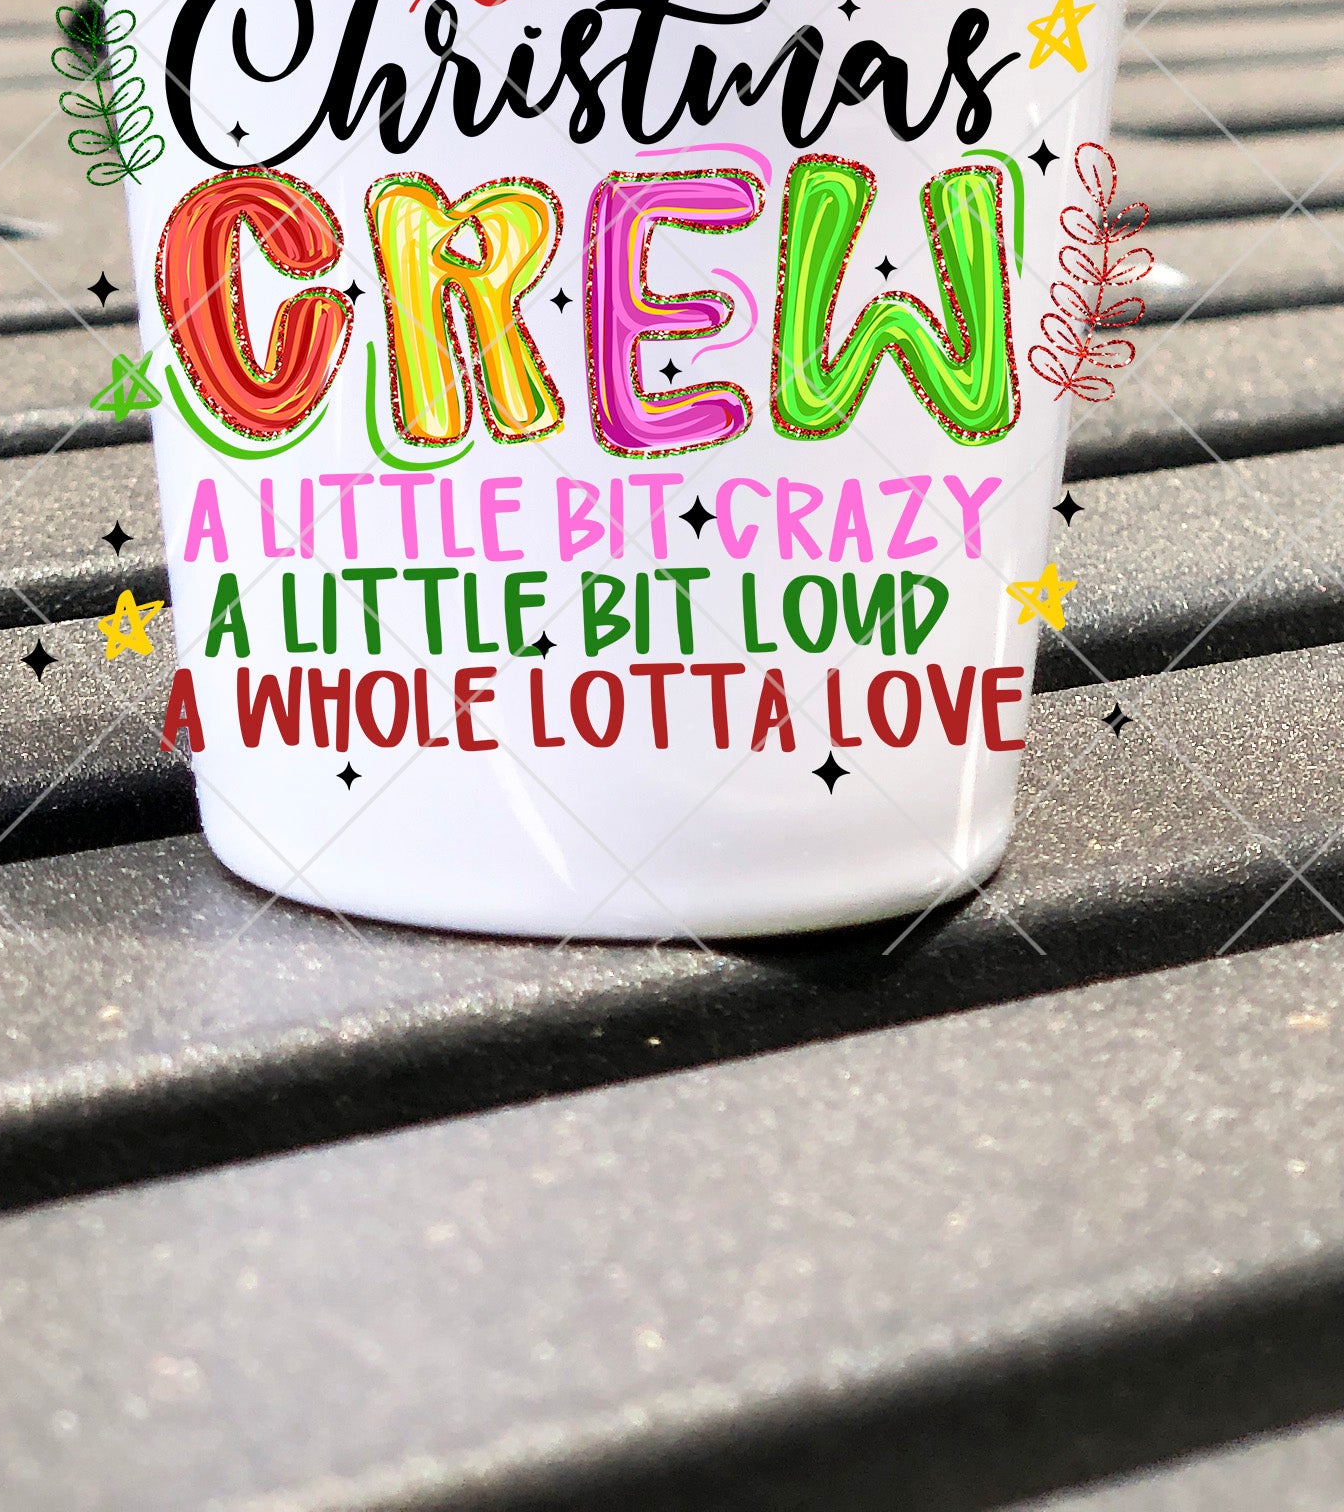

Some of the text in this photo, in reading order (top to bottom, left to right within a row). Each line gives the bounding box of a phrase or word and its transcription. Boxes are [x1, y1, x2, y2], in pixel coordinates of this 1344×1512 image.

[155, 153, 1023, 460] CREW
[182, 472, 1003, 563] A LITTLE BIT CRAZY
[204, 567, 950, 659] A LITTLE BIT LOUD
[160, 662, 1027, 753] A WHOLE LOTTA LOVE
